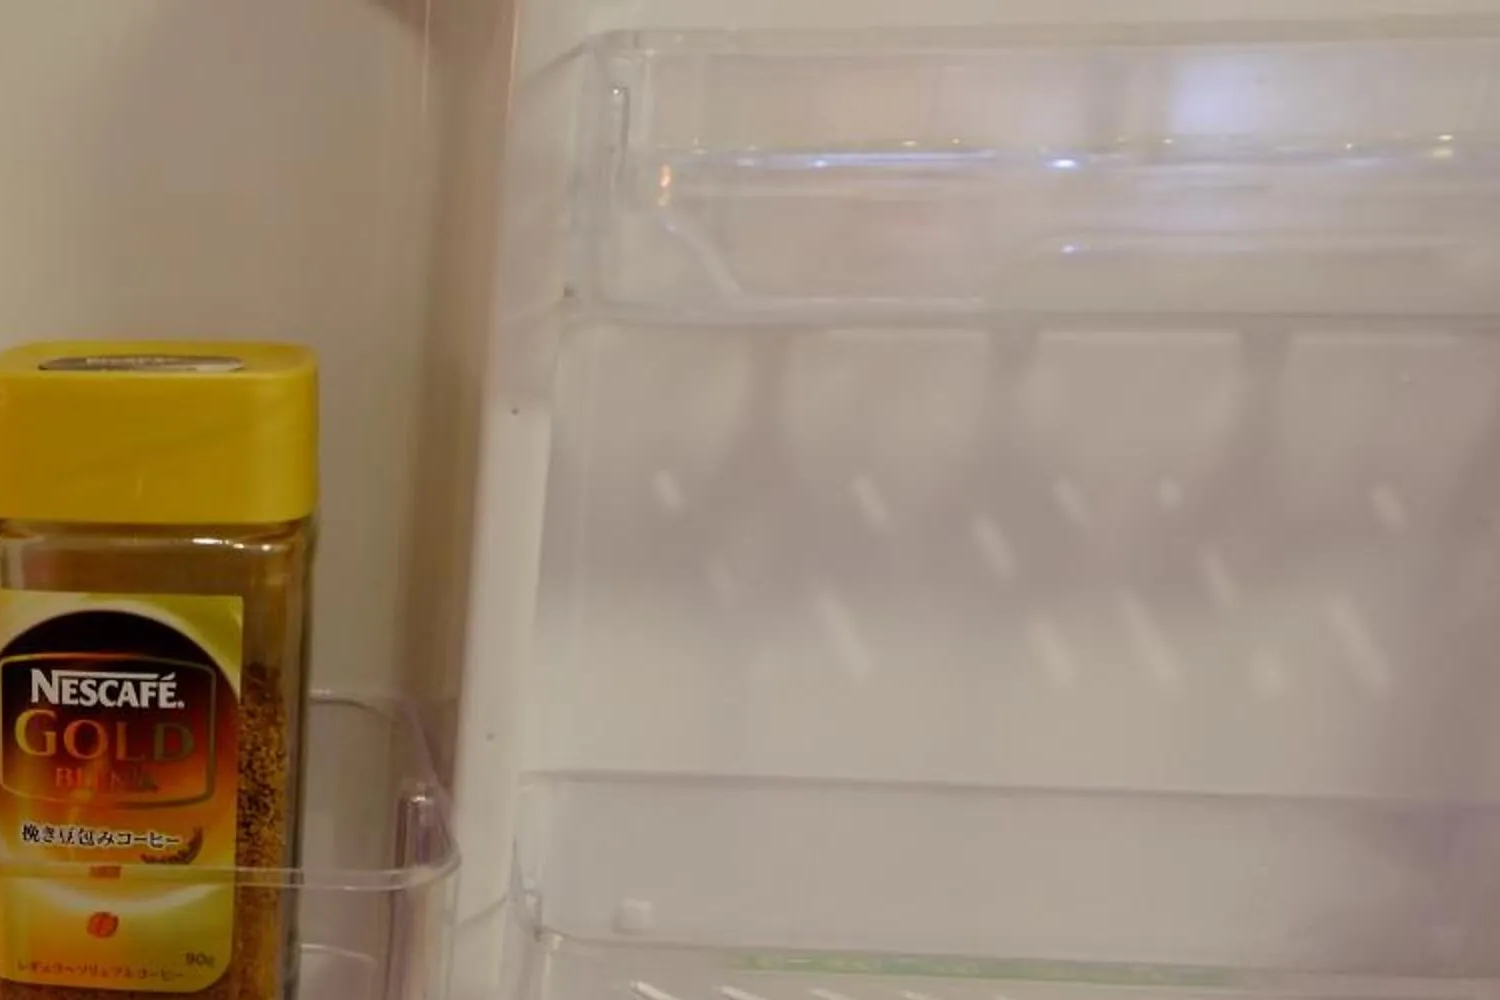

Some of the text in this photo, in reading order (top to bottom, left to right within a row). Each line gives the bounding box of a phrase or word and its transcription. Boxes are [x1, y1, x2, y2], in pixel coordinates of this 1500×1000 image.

[14, 708, 196, 765] GOLD
[55, 766, 158, 795] BLN
[21, 823, 181, 849] 挽き豆包みコーヒー
